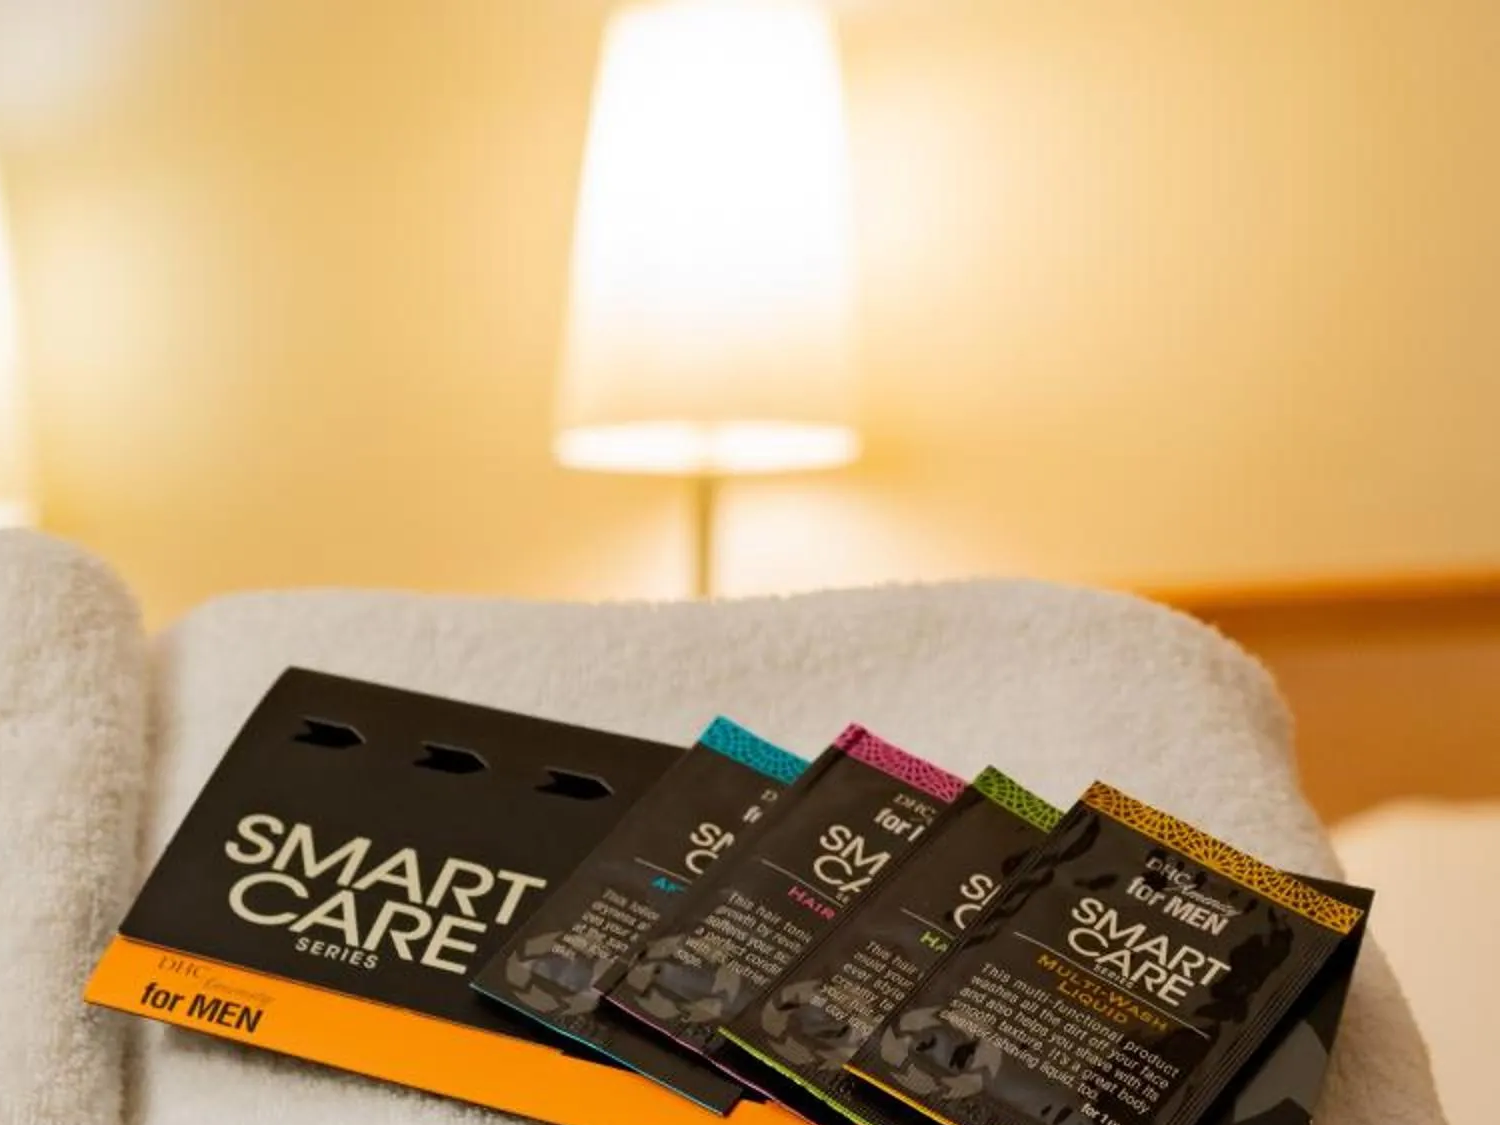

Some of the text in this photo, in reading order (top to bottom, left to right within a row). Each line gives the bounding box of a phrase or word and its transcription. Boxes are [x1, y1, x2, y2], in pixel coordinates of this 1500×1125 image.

[819, 824, 891, 876] SM
[874, 808, 911, 835] for
[225, 814, 547, 925] SMART
[1146, 856, 1193, 886] DHC
[228, 872, 486, 975] CARE
[787, 886, 836, 920] HAIR
[1126, 876, 1229, 937] for MEN
[295, 935, 378, 969] SERIES
[891, 956, 920, 975] hair
[1067, 926, 1195, 1008] CARE
[1071, 897, 1232, 986] SMART
[140, 981, 263, 1033] for MEN
[981, 963, 1012, 983] This
[1124, 1042, 1180, 1077] product
[1036, 953, 1169, 1031] MULTI-WASH
[1057, 980, 1130, 1025] LIQUID
[951, 998, 997, 1026] smooth
[1081, 1069, 1118, 1093] great
[1116, 1090, 1151, 1114] body
[961, 986, 1161, 1101] and also helps you shave with its
[972, 974, 1171, 1088] washes all the dirt off your face
[1080, 1104, 1100, 1118] for
